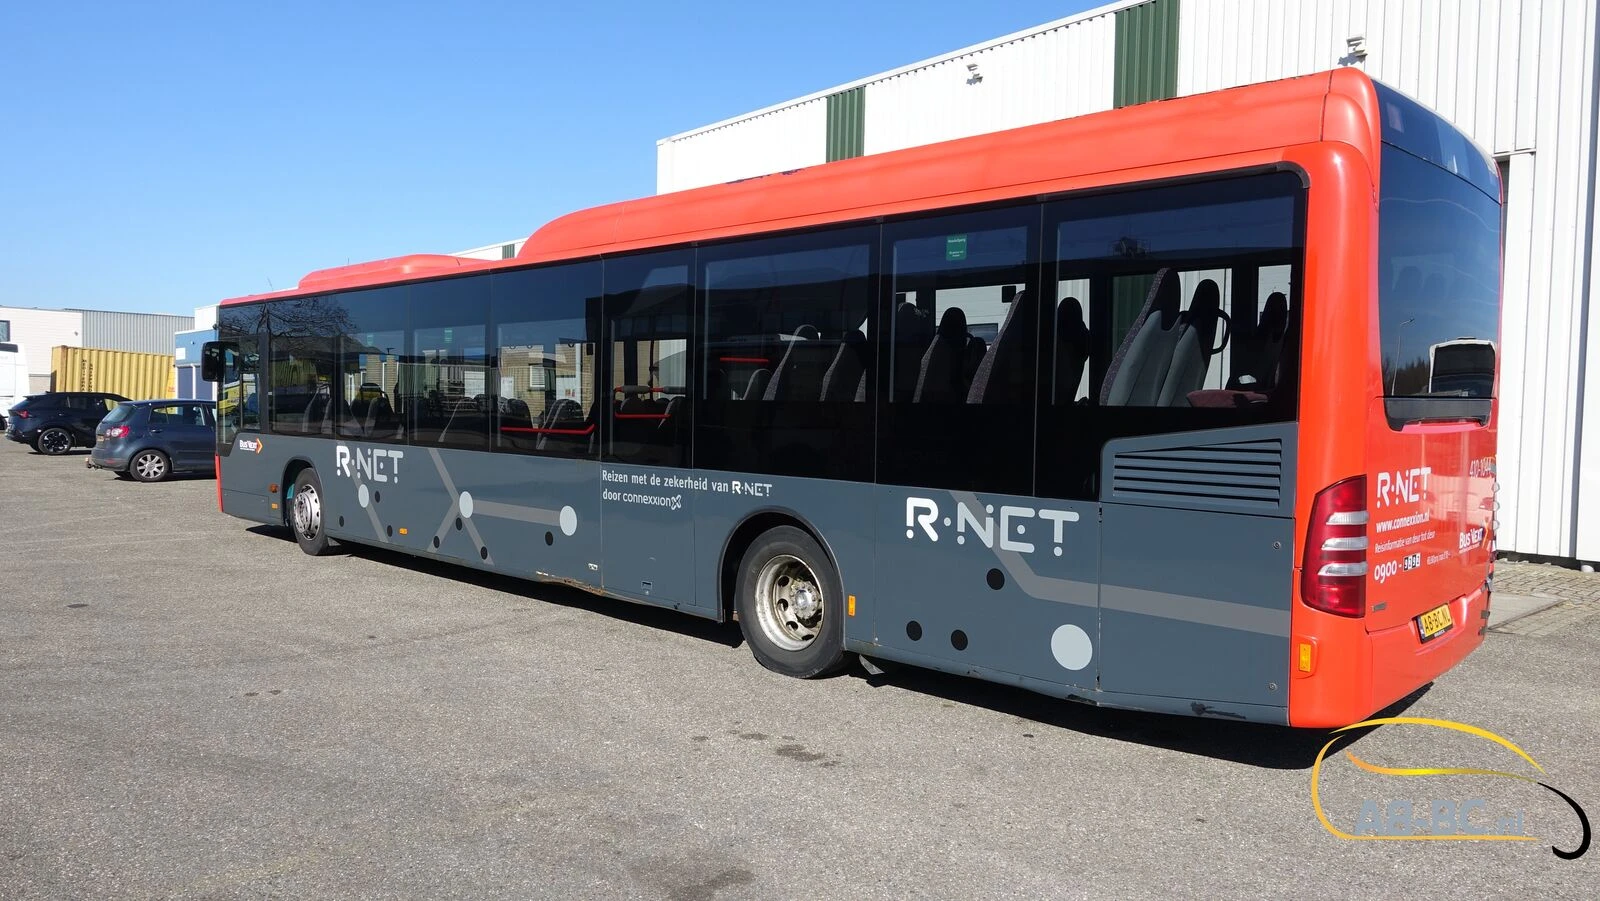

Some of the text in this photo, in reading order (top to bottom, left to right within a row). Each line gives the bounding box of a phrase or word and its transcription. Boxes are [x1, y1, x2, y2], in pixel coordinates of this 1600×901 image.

[602, 469, 628, 483] Reizen
[631, 473, 647, 485] met
[650, 474, 661, 486] de
[664, 477, 708, 491] zekerheid
[711, 482, 728, 493] van
[602, 488, 671, 508] door connexxion
[1375, 508, 1430, 534] www.connexxion.nl
[1374, 560, 1397, 584] 0900
